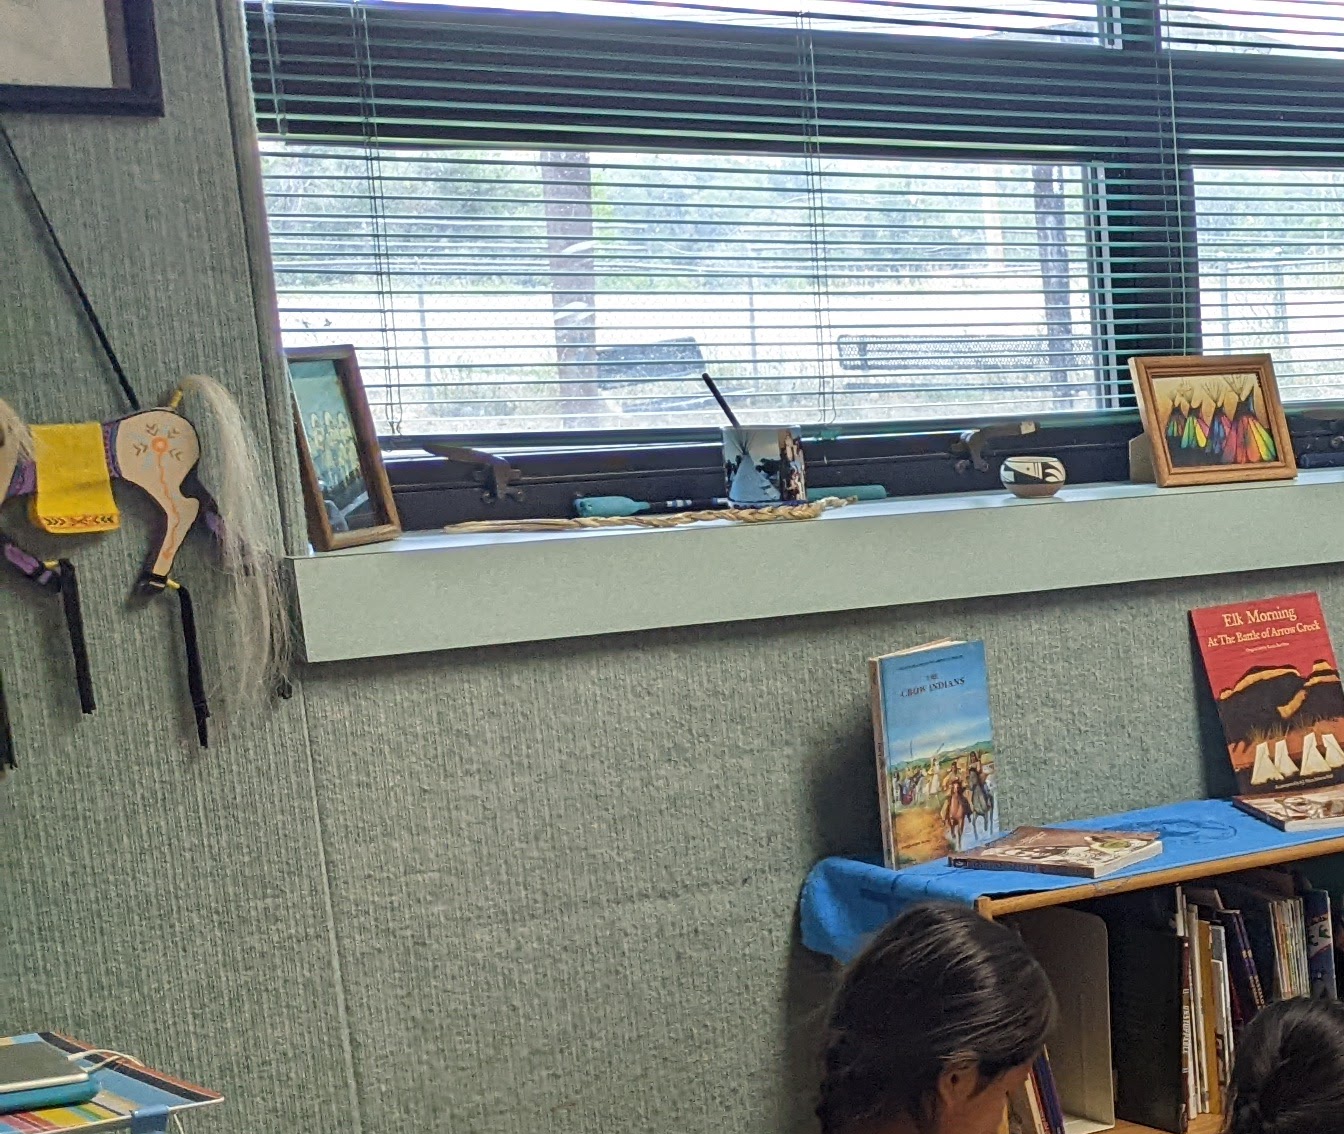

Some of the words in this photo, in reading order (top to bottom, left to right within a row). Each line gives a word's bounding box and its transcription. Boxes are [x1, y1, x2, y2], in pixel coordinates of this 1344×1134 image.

[1222, 611, 1244, 627] Elk
[1246, 606, 1297, 624] Morning
[1207, 636, 1219, 647] At
[1217, 634, 1236, 646] The
[1237, 630, 1260, 643] Battle
[1261, 627, 1271, 639] of
[1271, 625, 1296, 638] Arrow
[1296, 620, 1321, 632] Creek
[929, 677, 966, 692] INDIANS
